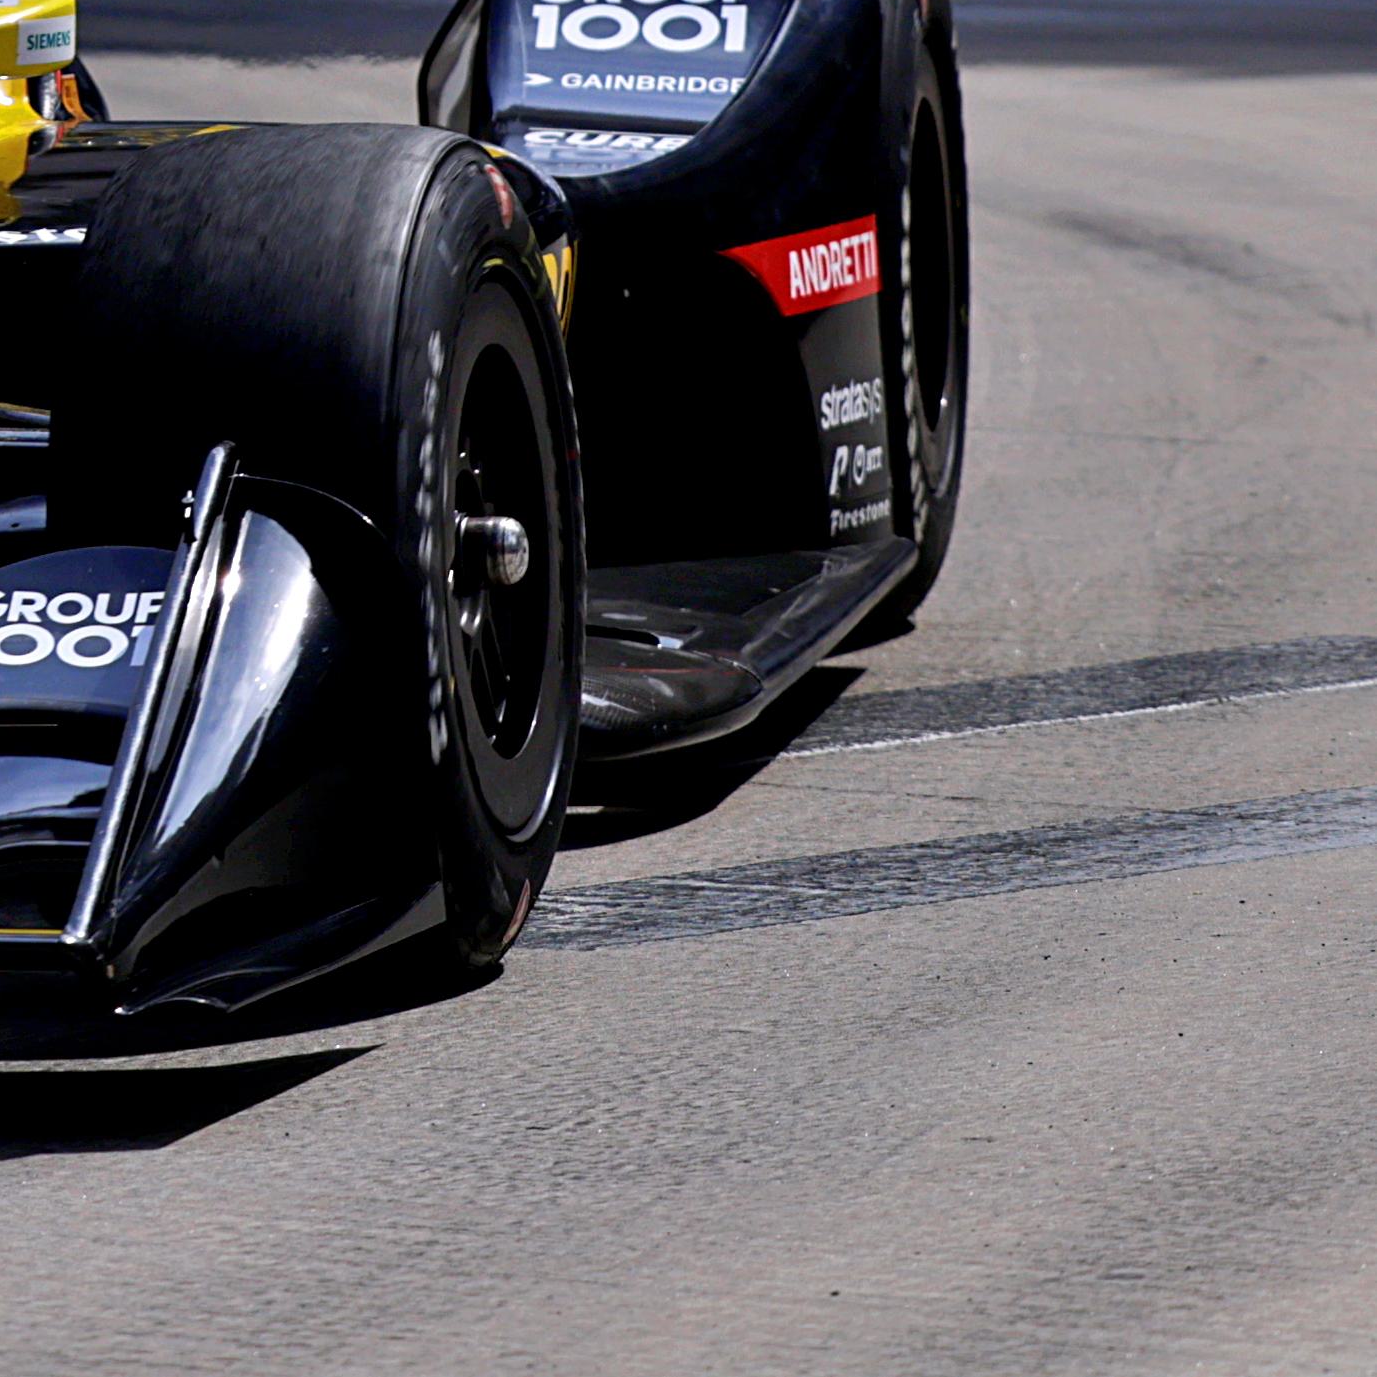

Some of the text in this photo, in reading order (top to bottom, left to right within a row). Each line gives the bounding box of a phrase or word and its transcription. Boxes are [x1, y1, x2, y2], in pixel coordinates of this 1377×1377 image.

[26, 29, 71, 51] SIEMENS
[533, 4, 747, 53] 1001
[560, 71, 745, 94] GAINBRIDGE
[789, 229, 877, 299] ANDRETTI
[830, 497, 890, 538] Firestone
